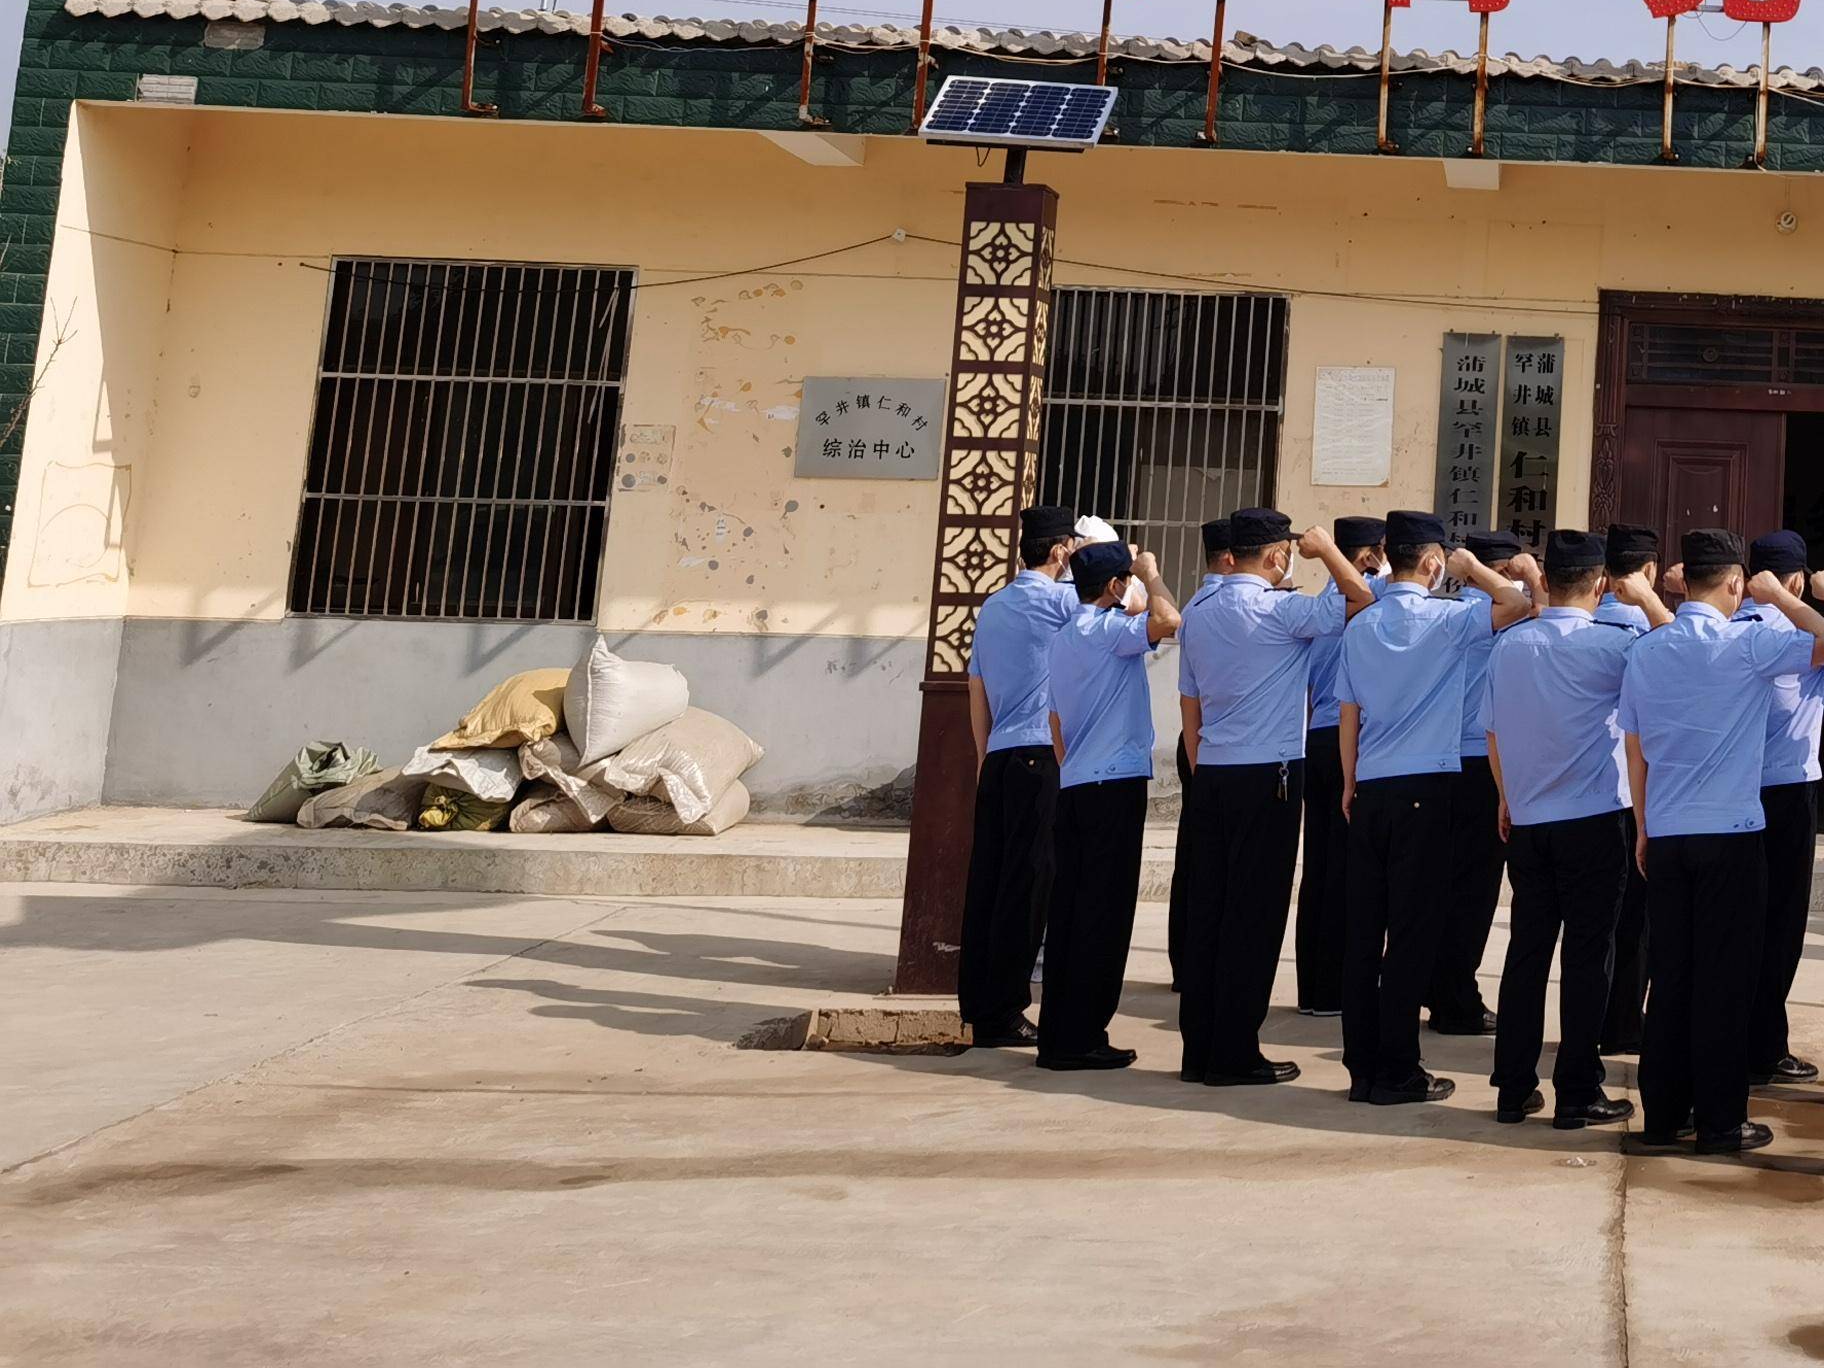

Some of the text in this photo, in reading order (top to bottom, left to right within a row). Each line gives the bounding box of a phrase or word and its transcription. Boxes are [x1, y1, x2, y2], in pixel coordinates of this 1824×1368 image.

[816, 395, 928, 431] 罕井镇仁和村
[1511, 352, 1534, 437] 罕井镇
[1532, 352, 1556, 438] 蒲城县
[823, 439, 915, 460] 综治中心
[1508, 451, 1548, 563] 仁和村
